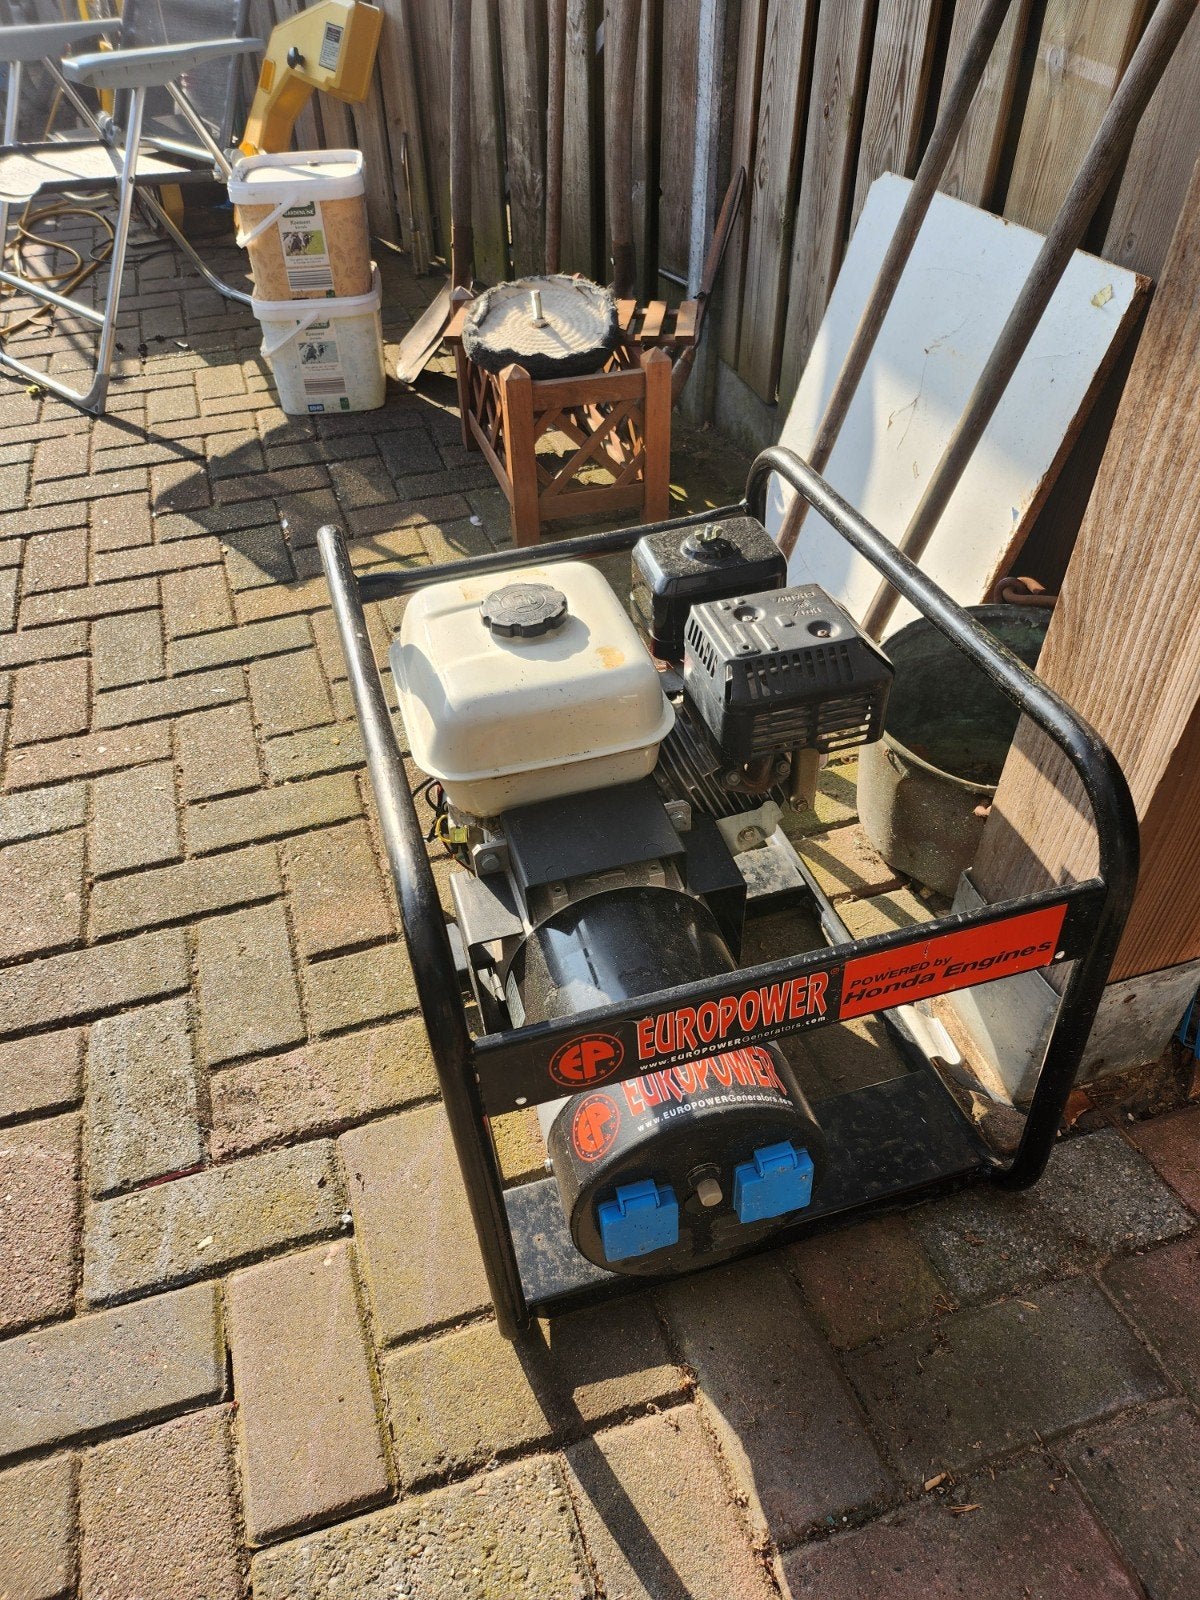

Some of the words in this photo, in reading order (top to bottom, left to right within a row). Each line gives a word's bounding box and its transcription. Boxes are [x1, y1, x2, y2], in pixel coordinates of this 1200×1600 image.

[843, 972, 936, 1005] Honda
[943, 941, 1053, 979] Engines
[850, 961, 930, 988] POWERED
[933, 956, 952, 968] by
[637, 971, 829, 1061] EUROPOWER
[639, 1015, 827, 1071] www.EUROPOWERGenerators.com
